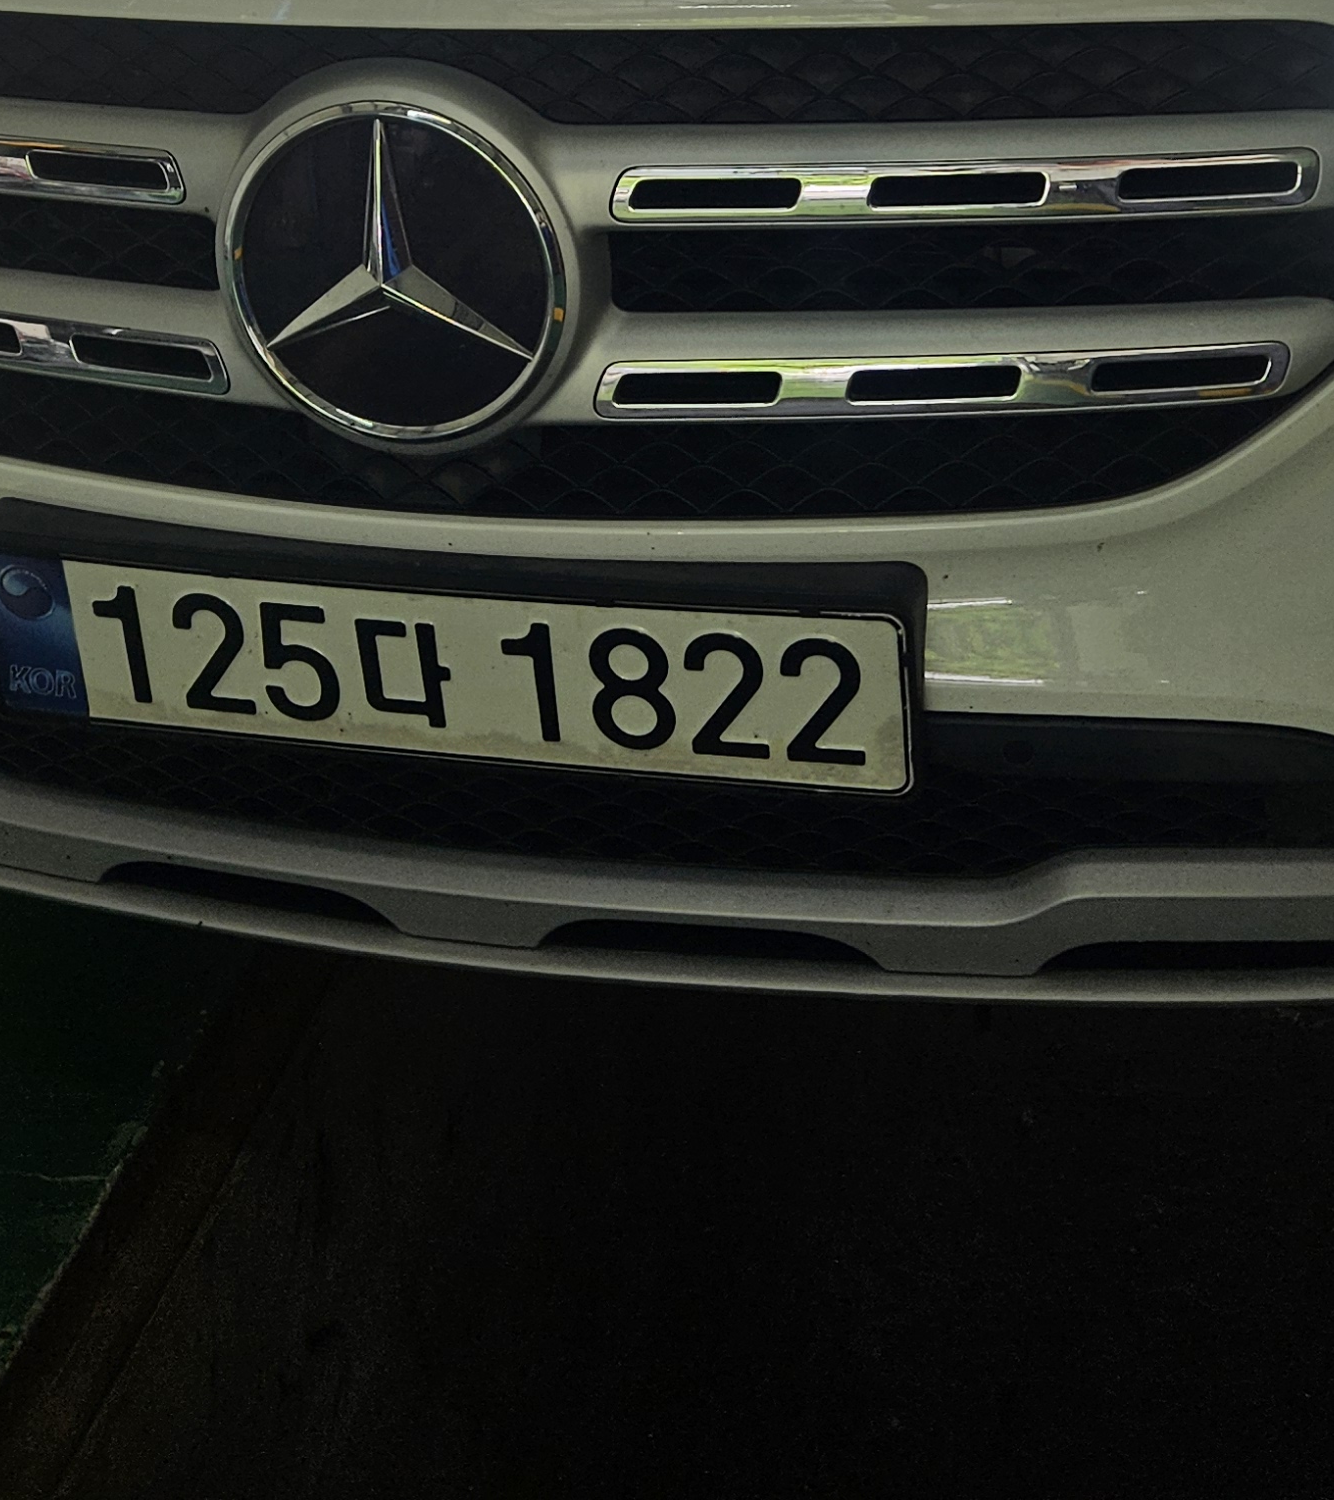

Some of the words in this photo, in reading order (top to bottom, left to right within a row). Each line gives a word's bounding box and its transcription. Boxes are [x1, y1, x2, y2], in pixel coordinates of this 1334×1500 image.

[8, 663, 77, 698] KOR
[91, 585, 452, 729] 125다
[500, 621, 867, 766] 1822
